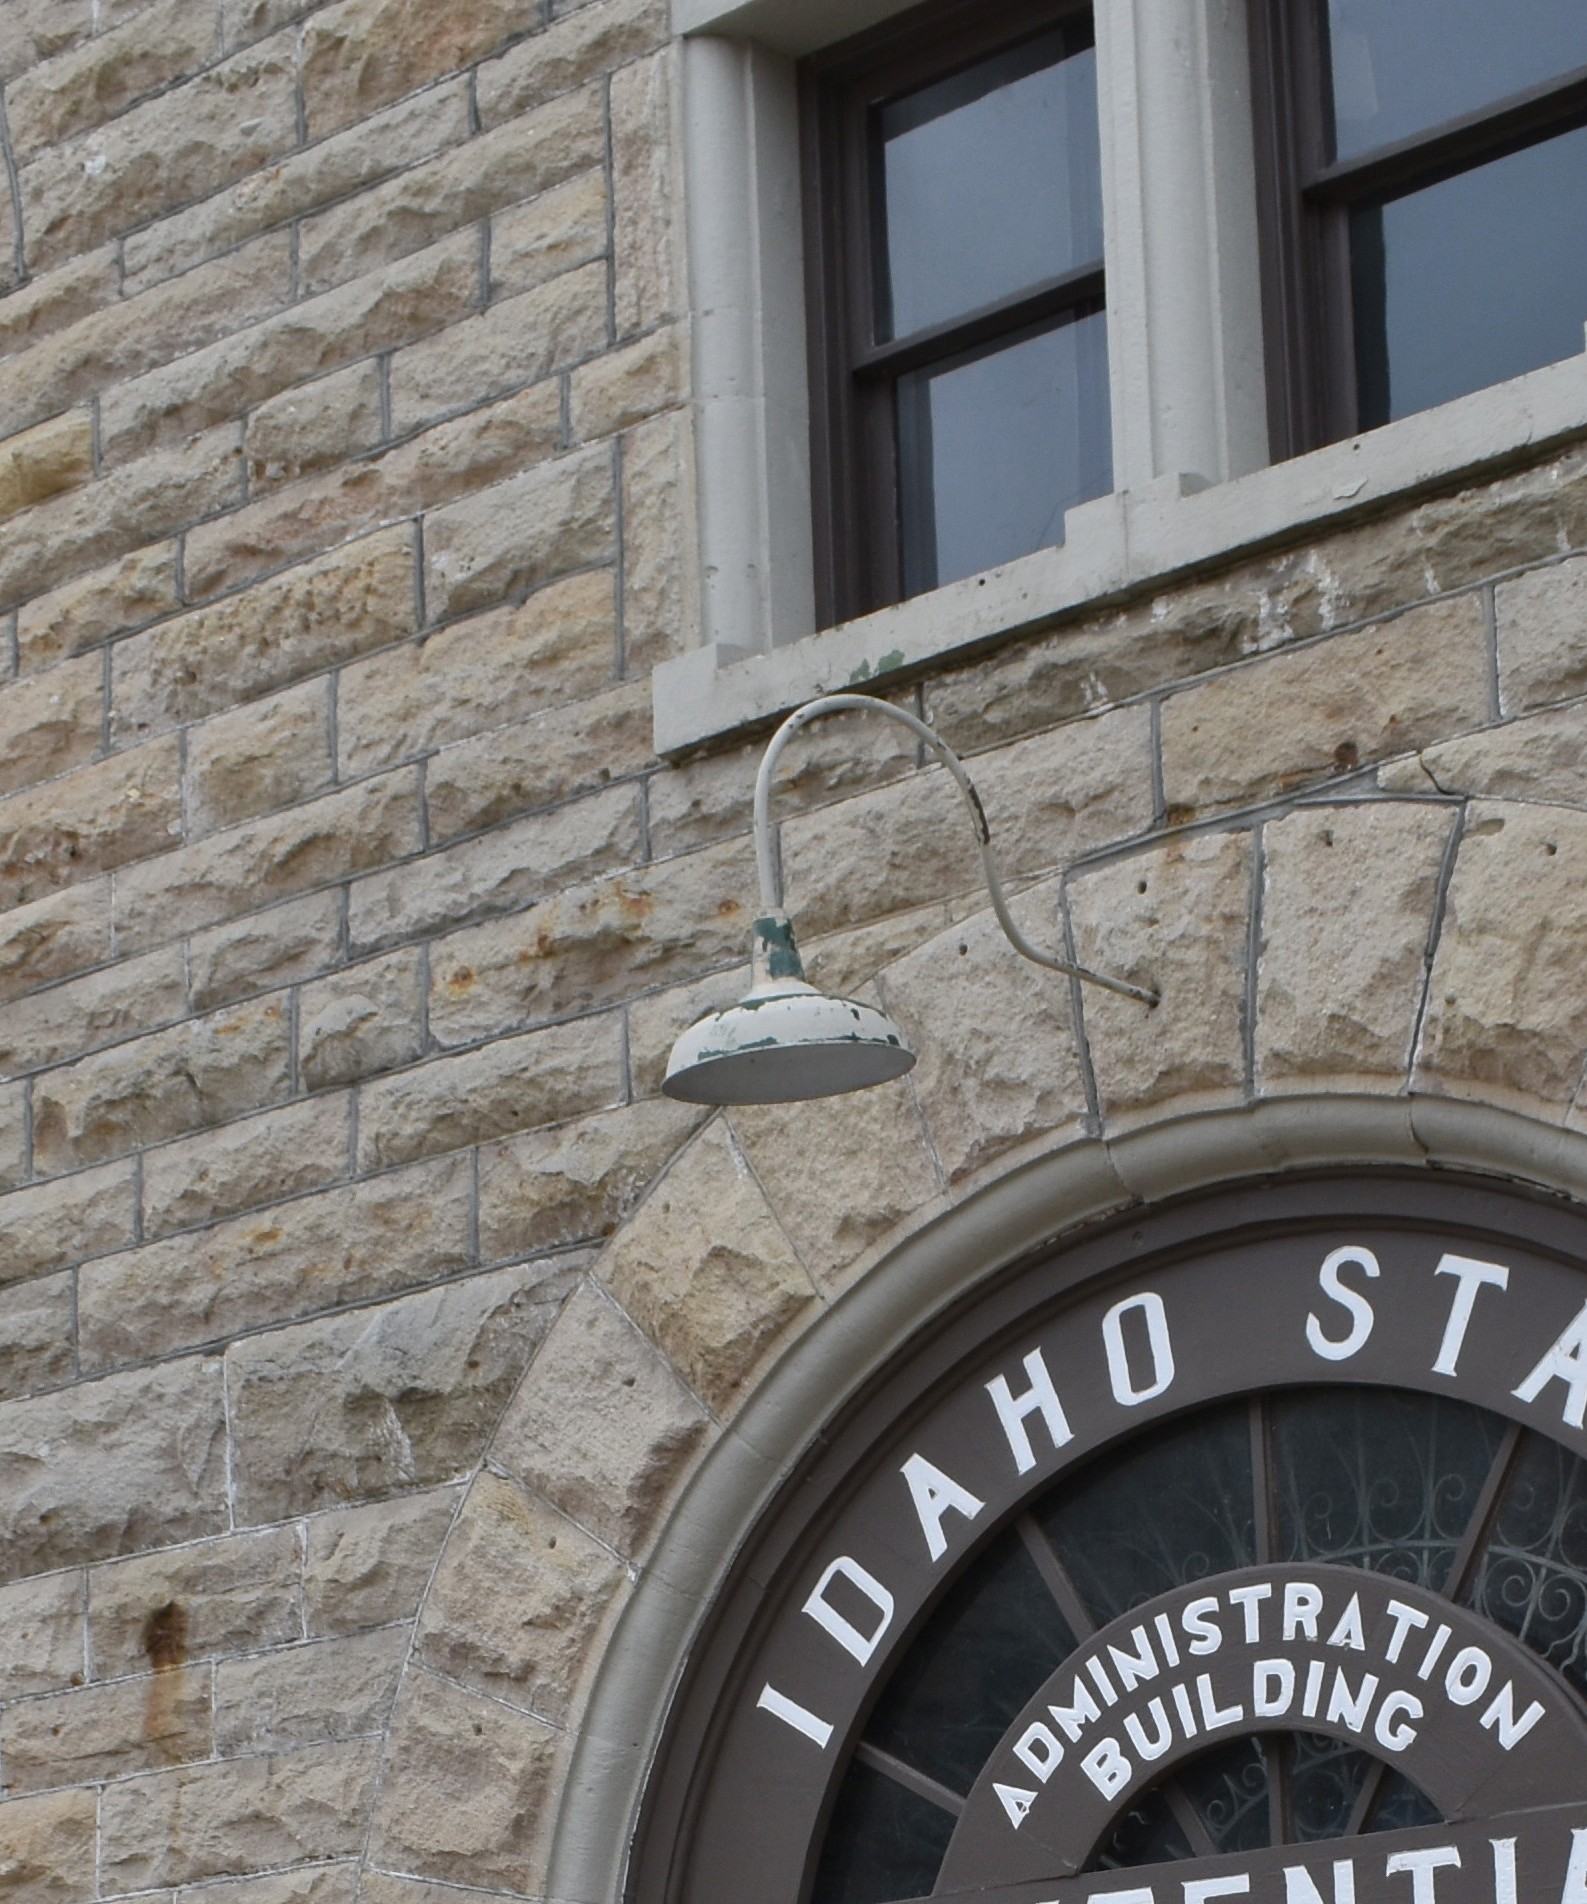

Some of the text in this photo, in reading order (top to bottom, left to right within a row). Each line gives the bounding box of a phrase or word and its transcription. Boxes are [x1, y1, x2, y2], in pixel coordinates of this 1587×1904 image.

[756, 1291, 1176, 1750] IDAHO
[992, 1580, 1546, 1830] ADMINISTRATION
[1081, 1659, 1424, 1800] BUILDING
